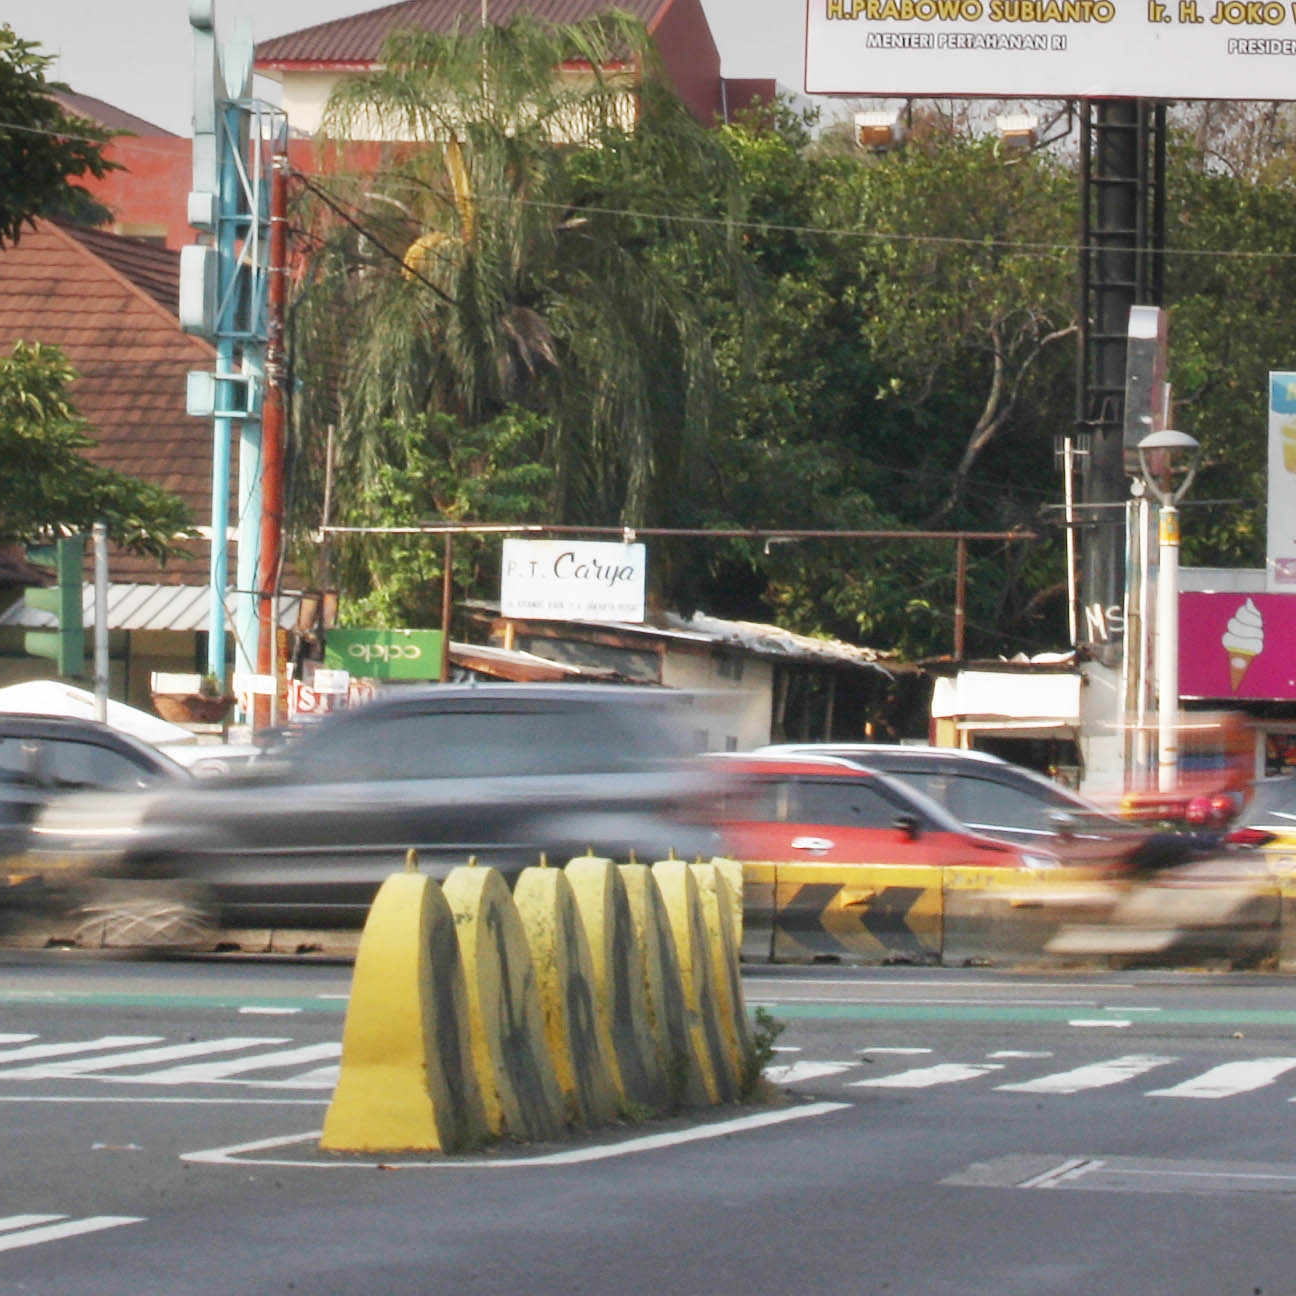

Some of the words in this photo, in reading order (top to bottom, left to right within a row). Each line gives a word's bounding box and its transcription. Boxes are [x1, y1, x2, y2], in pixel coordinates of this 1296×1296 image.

[1178, 0, 1204, 24] H.
[1210, 0, 1286, 25] JOKO
[865, 32, 935, 49] MENTERI
[937, 33, 1051, 50] PERTAHANAN
[1051, 35, 1067, 52] RI
[553, 551, 635, 587] Carya
